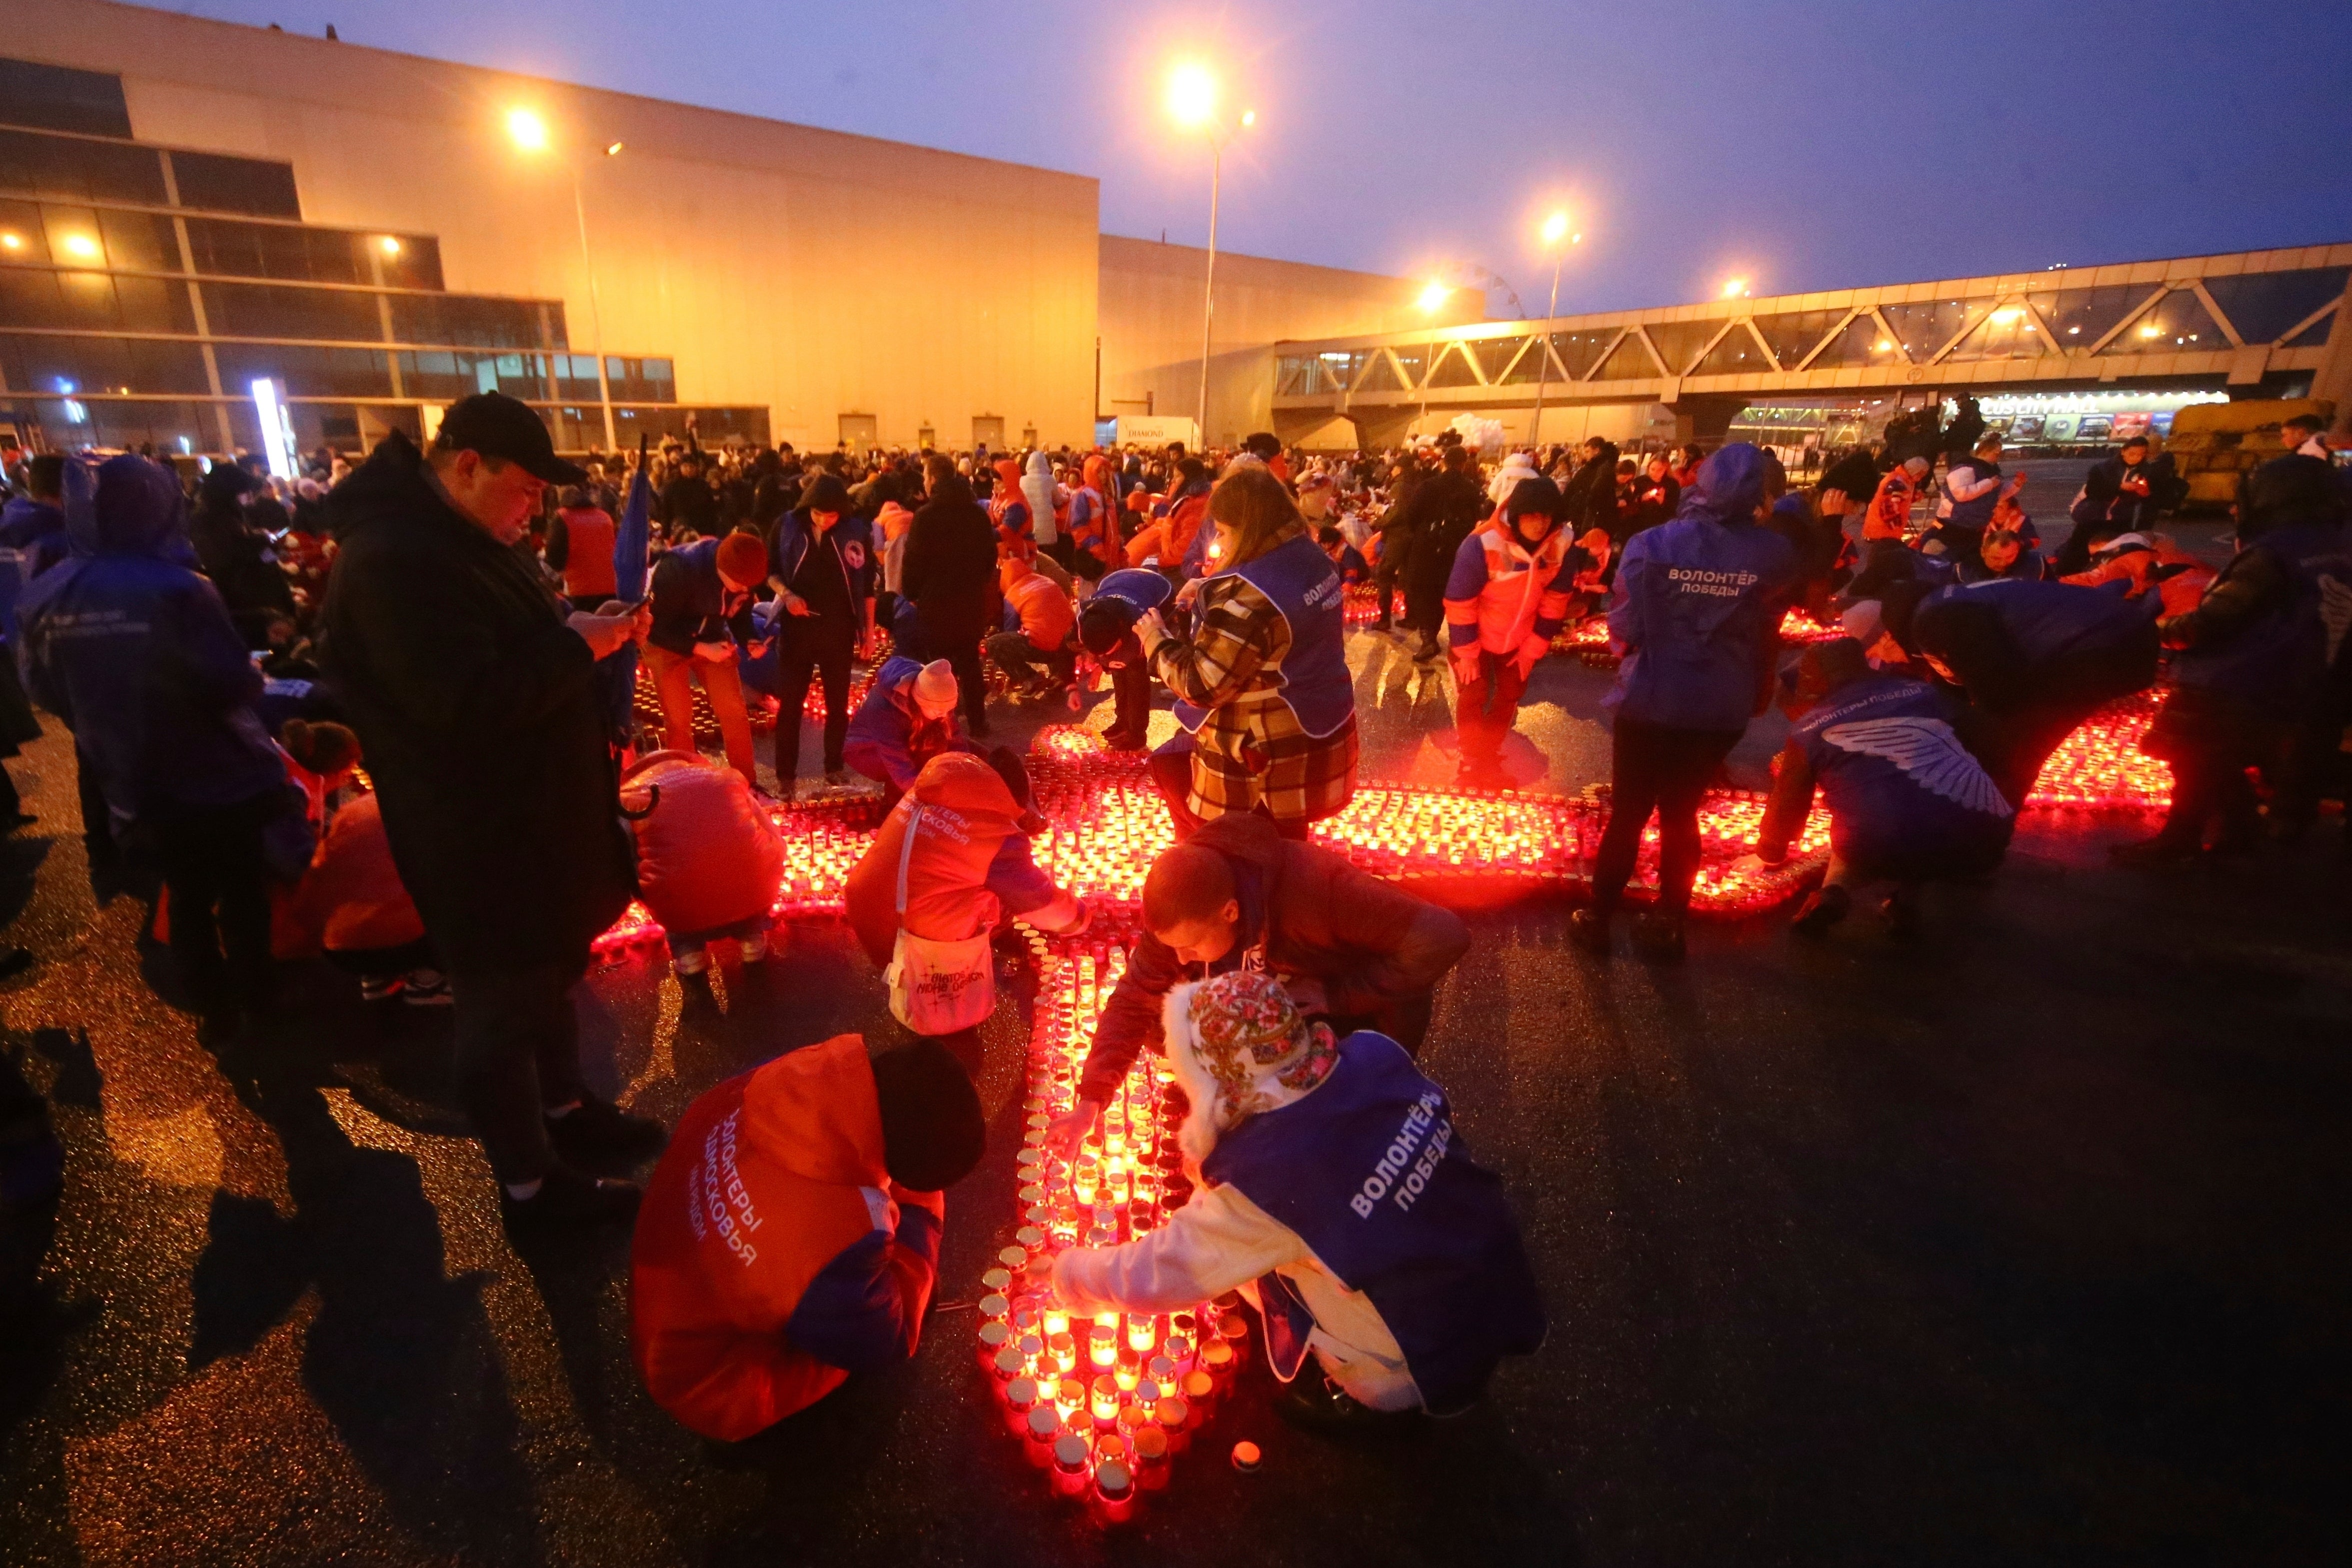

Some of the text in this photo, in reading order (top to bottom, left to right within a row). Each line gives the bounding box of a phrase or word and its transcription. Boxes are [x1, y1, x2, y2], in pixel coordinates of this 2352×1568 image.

[2016, 401, 2052, 414] CITY
[2053, 400, 2100, 413] HALL
[1669, 569, 1758, 585] ВОЛОНТЁР
[1681, 583, 1740, 597] ПОБЕДЫ
[1869, 687, 1922, 702] ПОБЕДЫ
[1394, 1119, 1452, 1212] ПОБЕДЫ
[705, 1125, 758, 1267] ОДМОСКОВЬЯ
